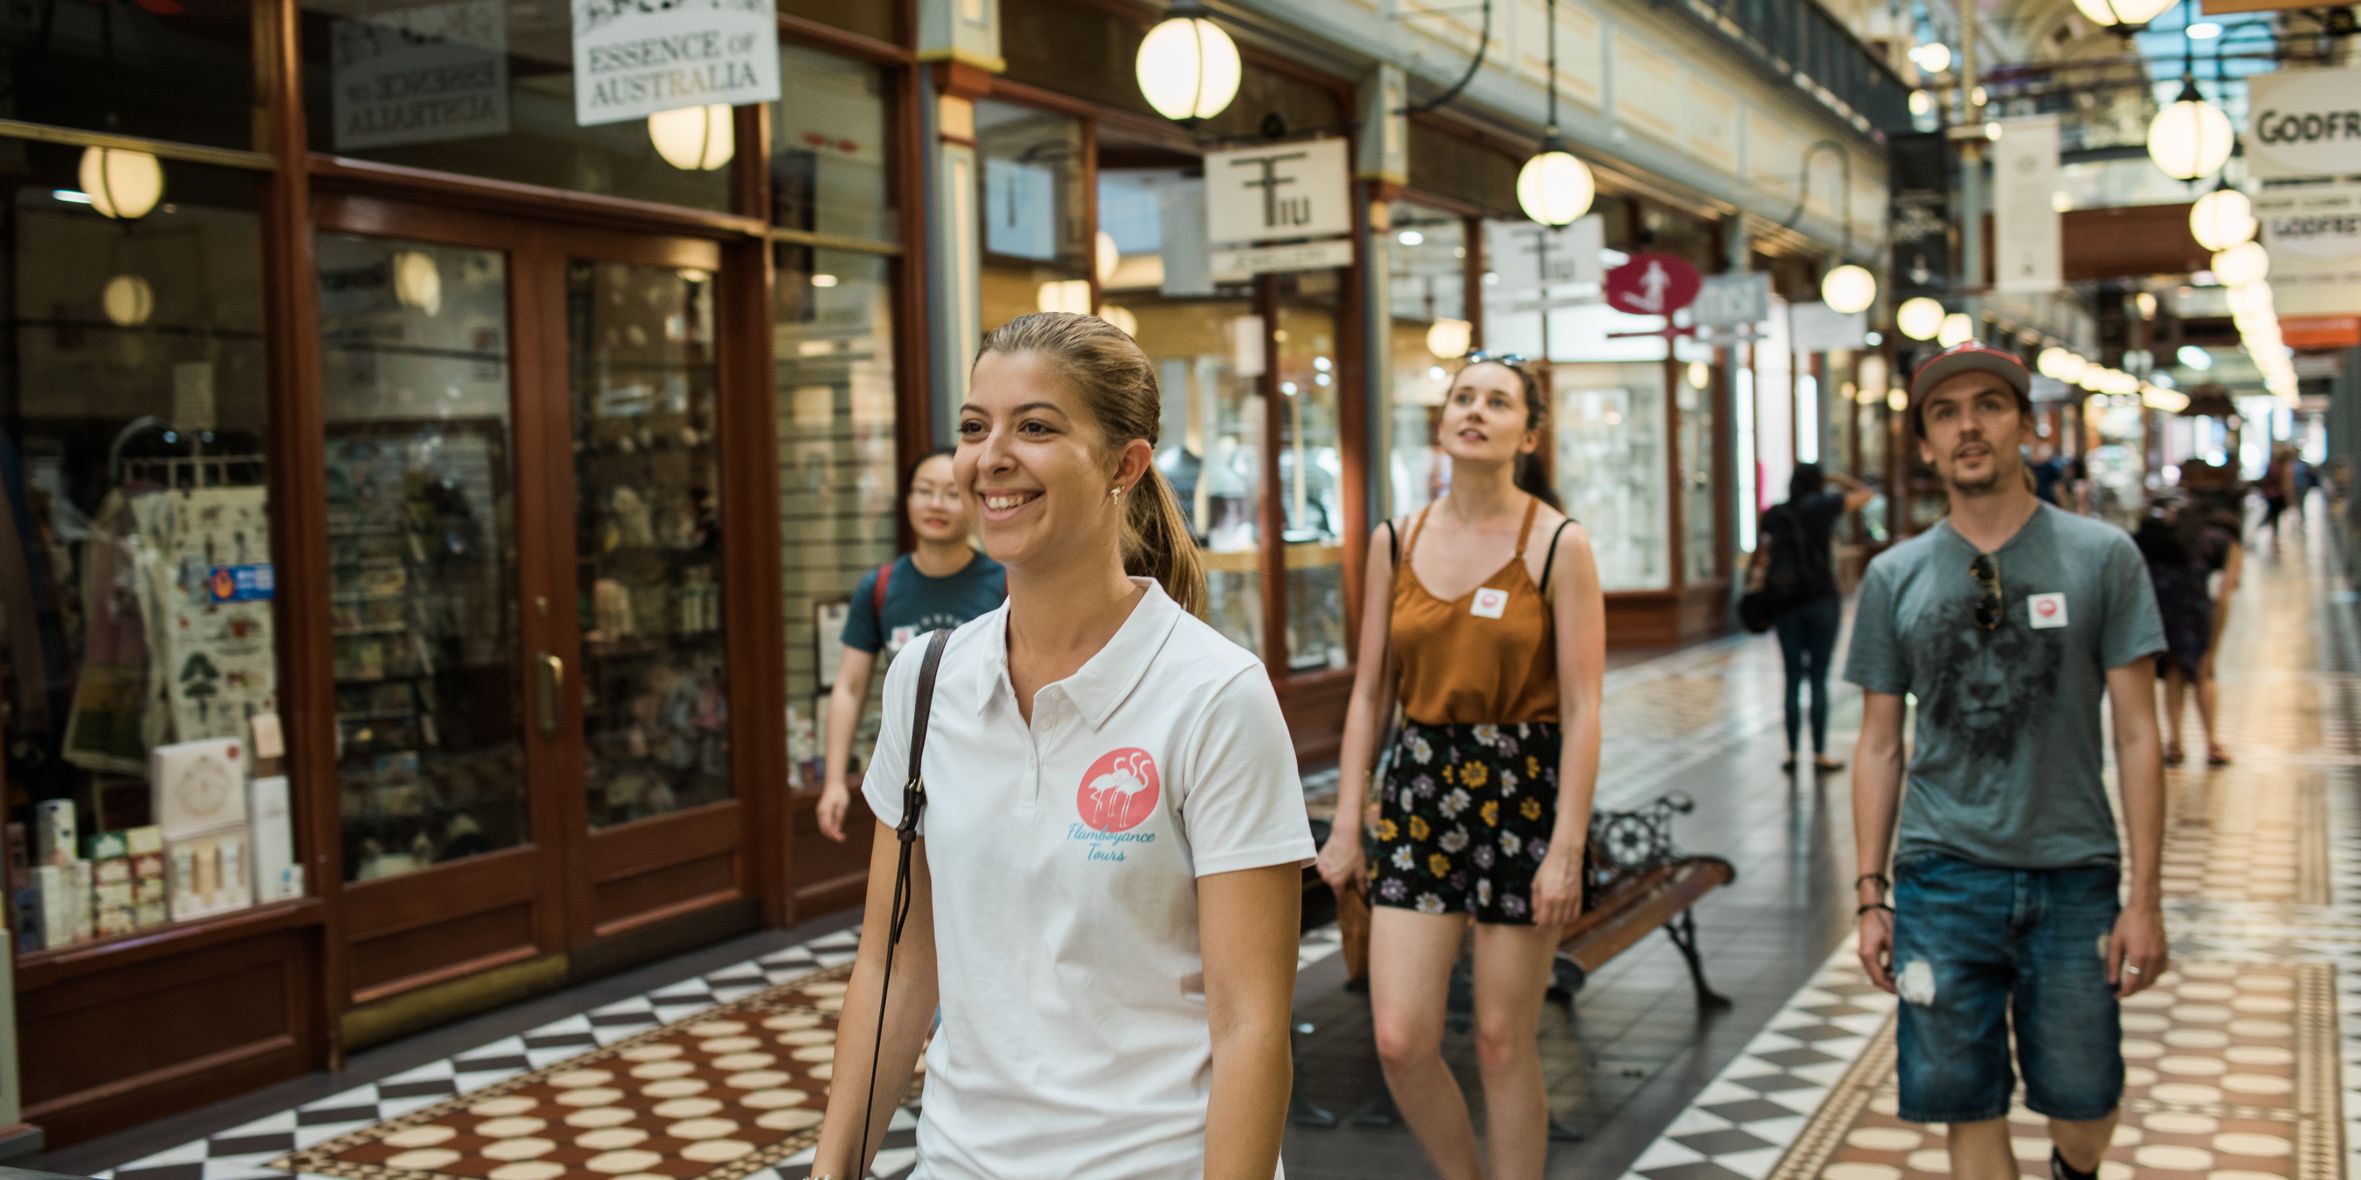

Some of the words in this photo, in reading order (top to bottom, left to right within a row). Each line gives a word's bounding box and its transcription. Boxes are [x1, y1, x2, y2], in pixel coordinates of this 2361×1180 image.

[589, 31, 720, 73] ESSENCE
[727, 32, 758, 54] OF
[591, 61, 758, 108] AUSTRALIA
[2273, 215, 2361, 240] GODFRE
[1066, 823, 1157, 846] Flamboyance
[1087, 843, 1126, 862] Tours
